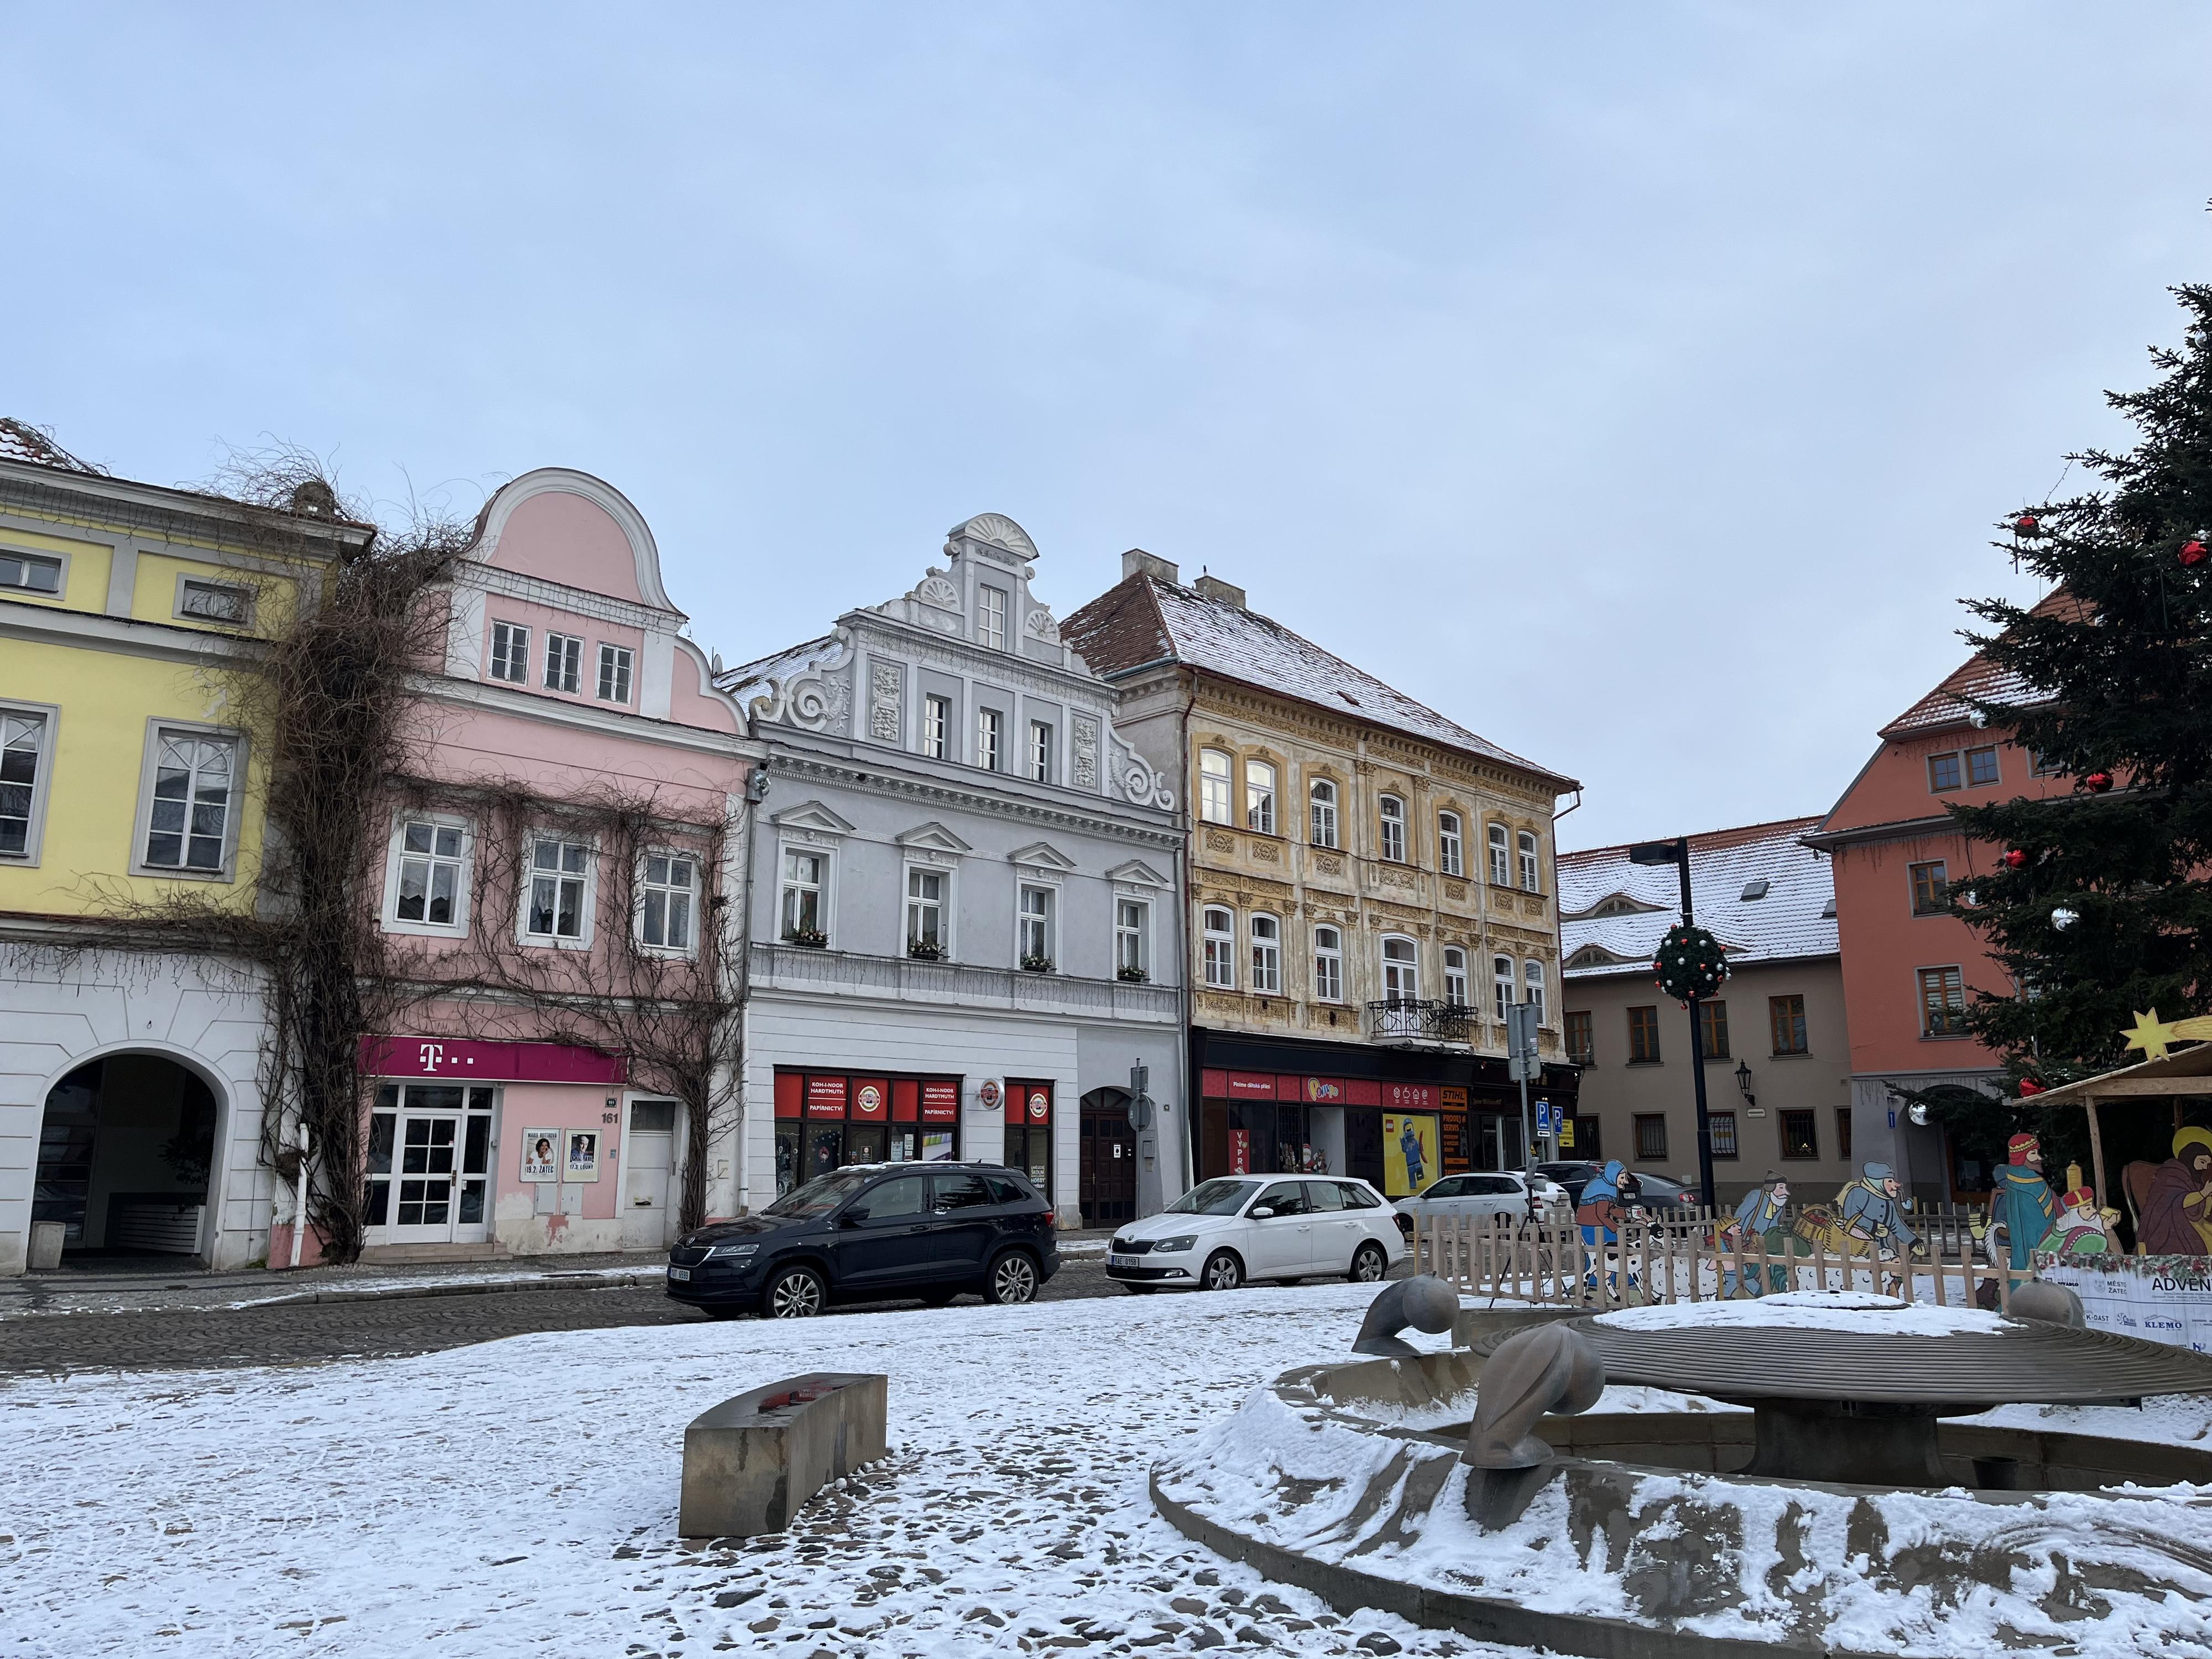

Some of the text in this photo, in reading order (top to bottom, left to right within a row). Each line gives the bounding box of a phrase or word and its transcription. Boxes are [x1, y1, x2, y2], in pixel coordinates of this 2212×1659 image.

[1442, 1090, 1465, 1100] STIHL
[1540, 1104, 1546, 1120] P
[1554, 1110, 1561, 1125] P
[602, 1113, 618, 1124] 161
[1443, 1114, 1461, 1124] PRODEJ
[539, 1165, 554, 1173] ŽATEC
[2152, 1277, 2212, 1292] ADVEN
